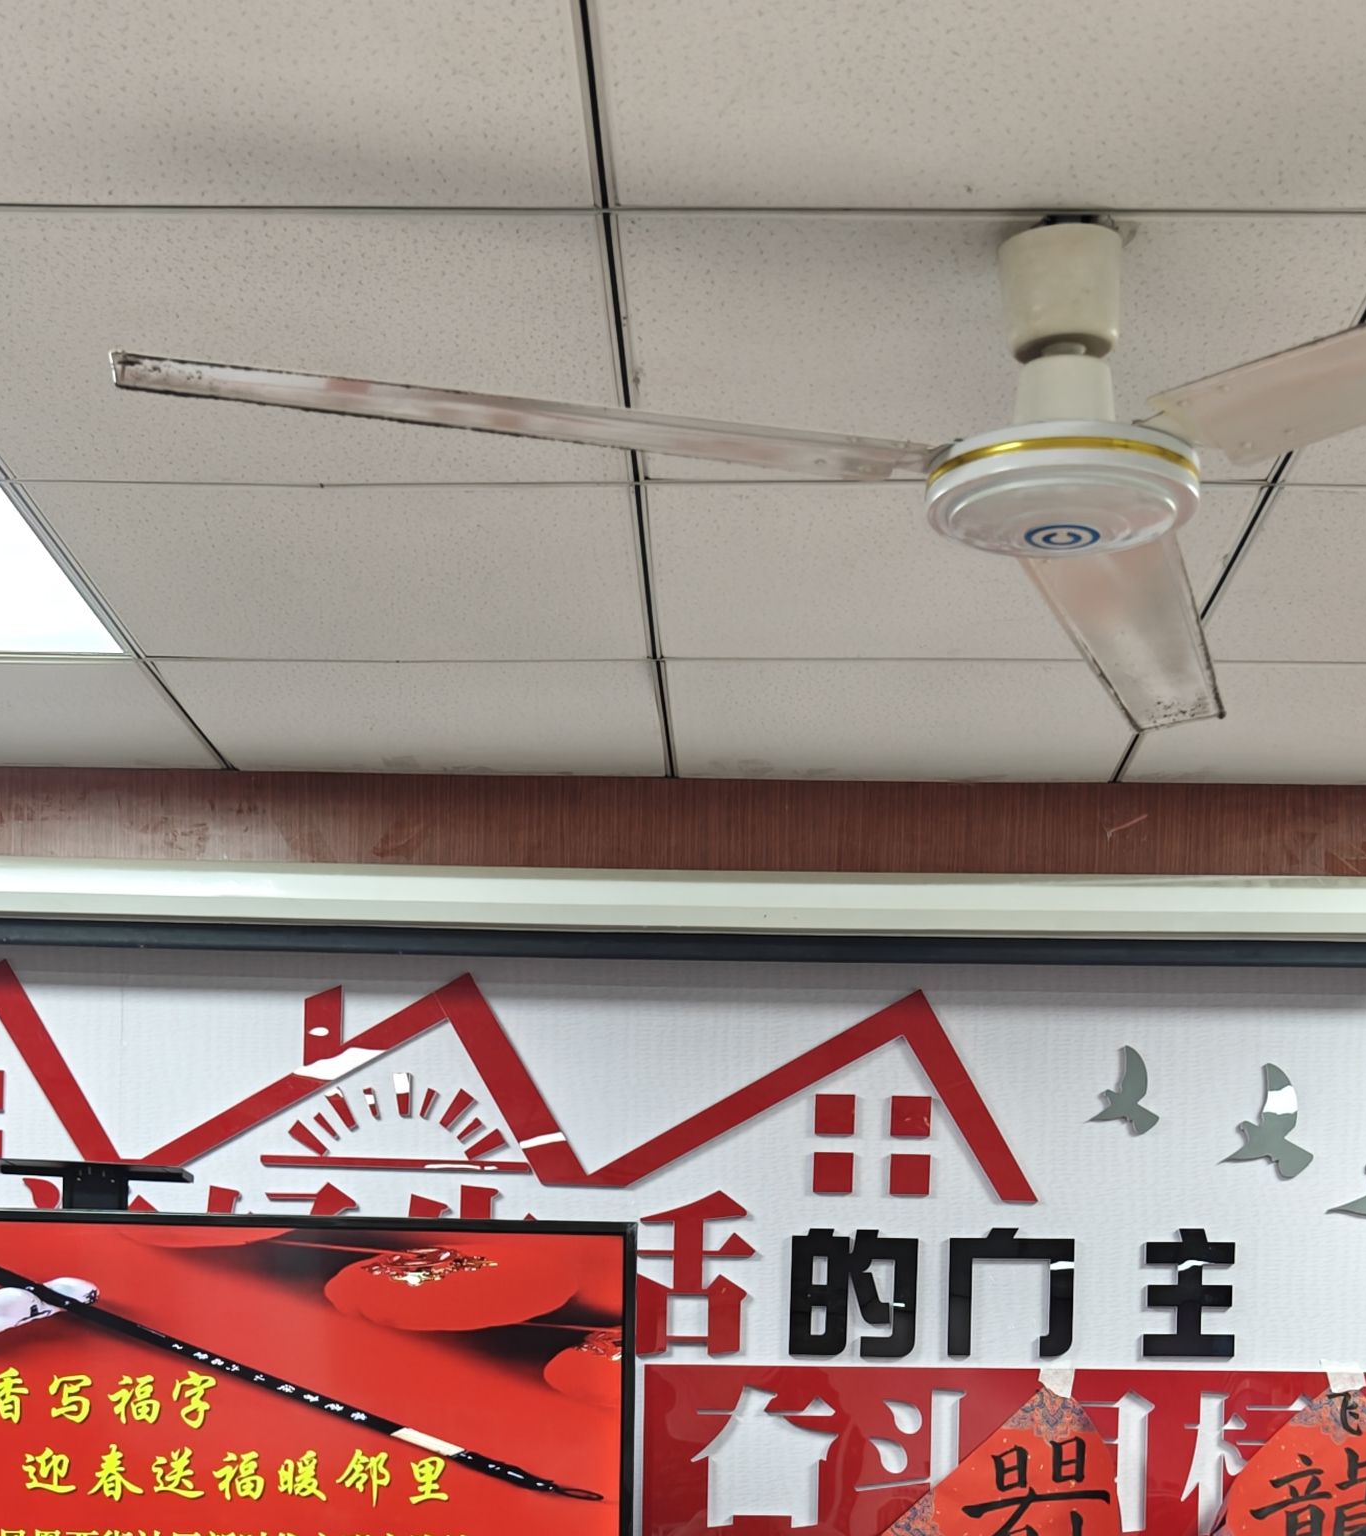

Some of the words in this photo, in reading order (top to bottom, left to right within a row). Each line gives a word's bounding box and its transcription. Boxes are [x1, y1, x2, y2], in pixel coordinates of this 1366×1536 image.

[21, 1443, 453, 1507] 迎春送福暖邻里
